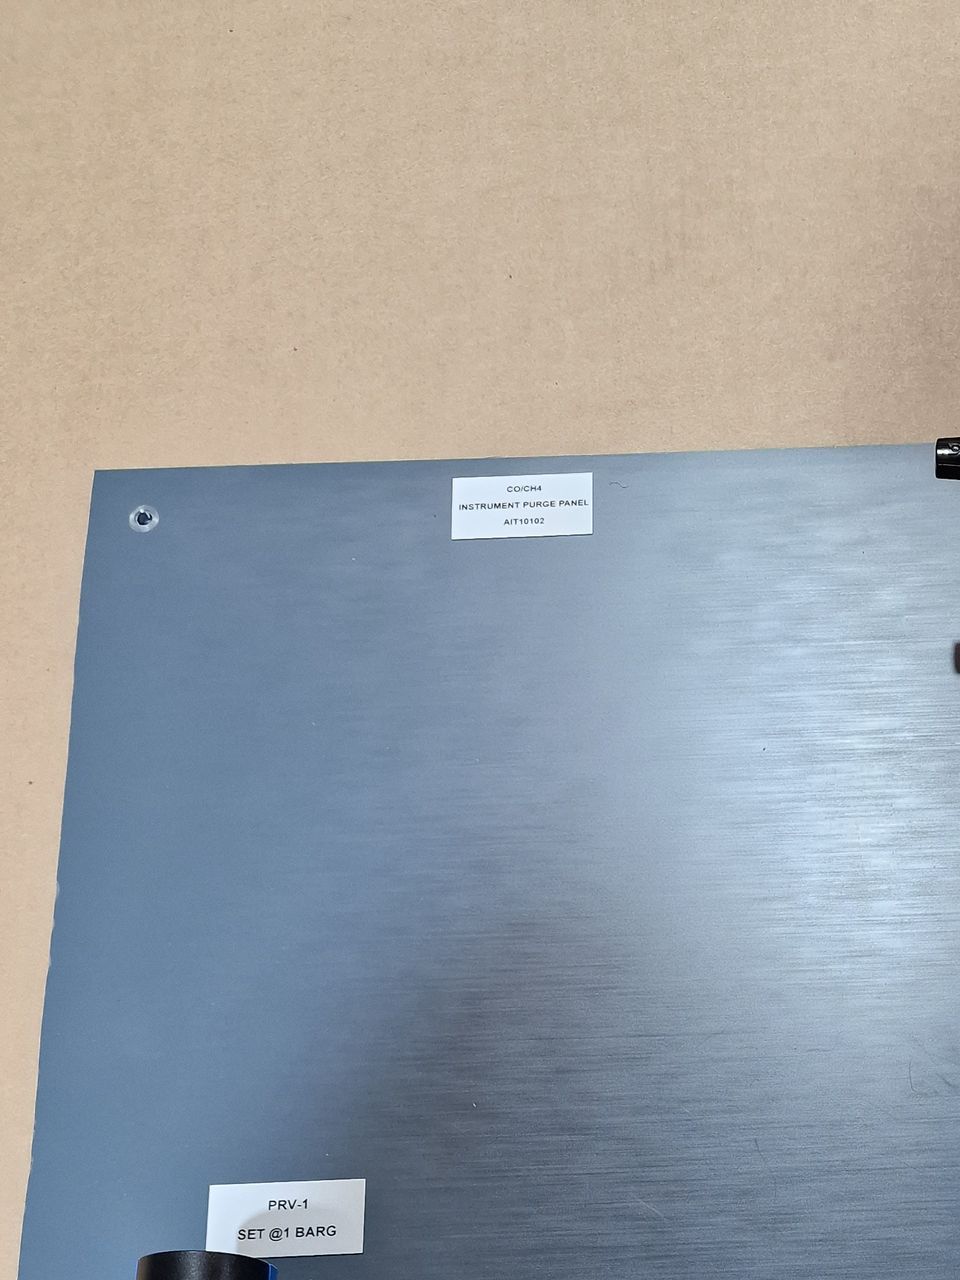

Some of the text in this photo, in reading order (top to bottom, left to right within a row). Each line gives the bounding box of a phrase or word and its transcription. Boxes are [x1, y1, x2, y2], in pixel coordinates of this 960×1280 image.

[506, 485, 542, 493] CO/CH4
[459, 499, 589, 511] INSTRUMENT PURGE PANEL
[503, 517, 545, 526] AIT10102
[268, 1198, 308, 1211] PRV-1
[237, 1225, 337, 1241] SET @1 BARG
